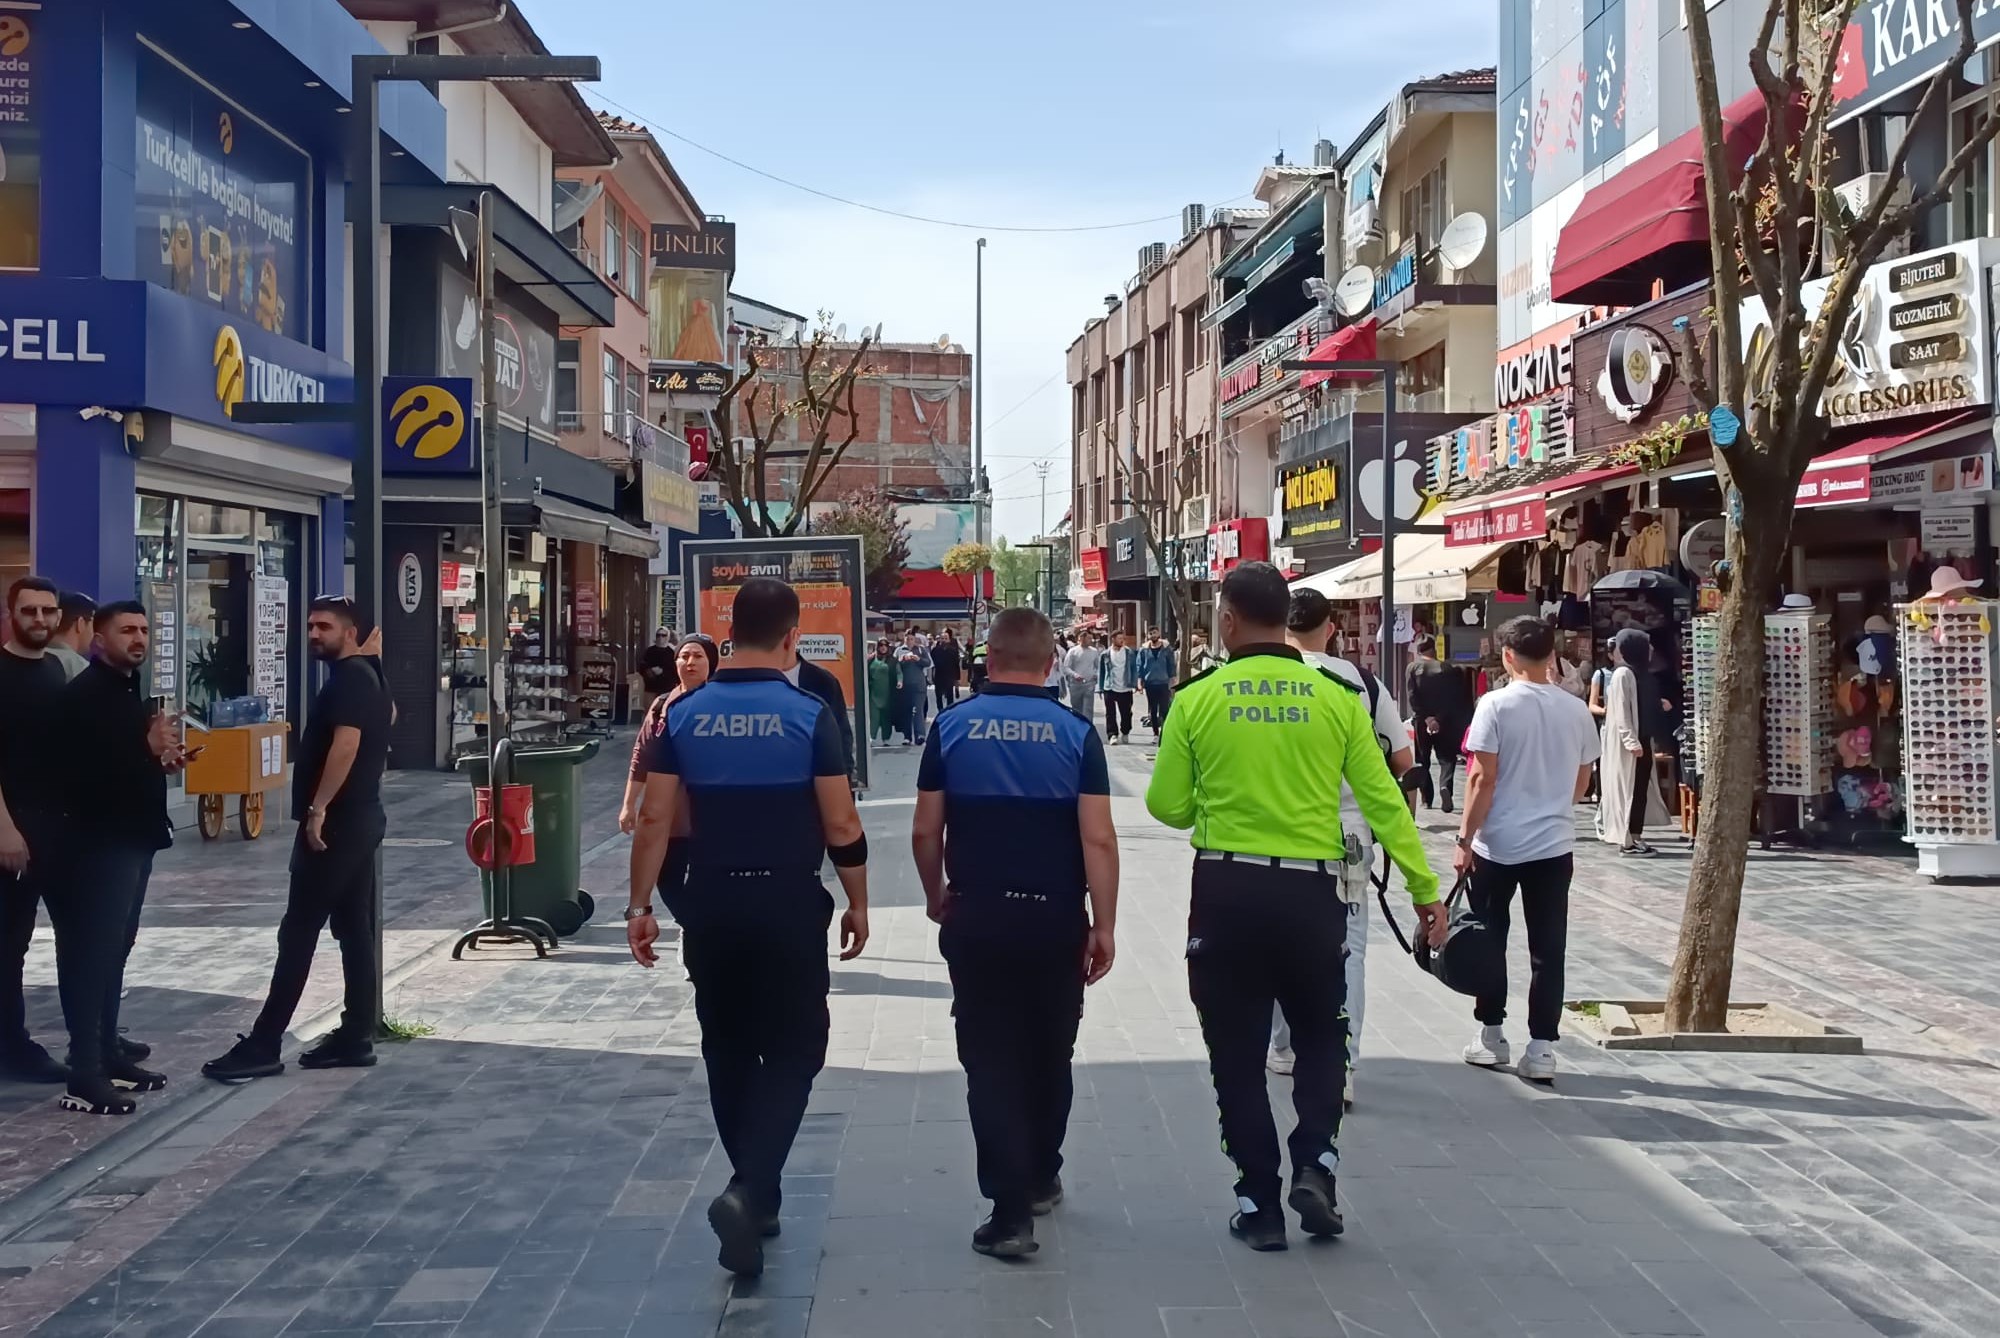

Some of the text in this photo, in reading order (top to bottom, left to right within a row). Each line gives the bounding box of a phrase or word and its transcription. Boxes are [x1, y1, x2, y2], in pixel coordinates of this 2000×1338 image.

[211, 165, 251, 218] bağlan
[254, 193, 294, 246] hayata!
[653, 231, 726, 256] LİNLİK
[1900, 259, 1945, 287] BİJUTERİ
[1895, 300, 1952, 327] KOZMETİK
[1909, 342, 1940, 361] SAAT
[712, 562, 749, 581] soylu
[750, 564, 781, 576] avm
[693, 713, 785, 738] ZABITA
[967, 718, 1057, 744] ZABITA
